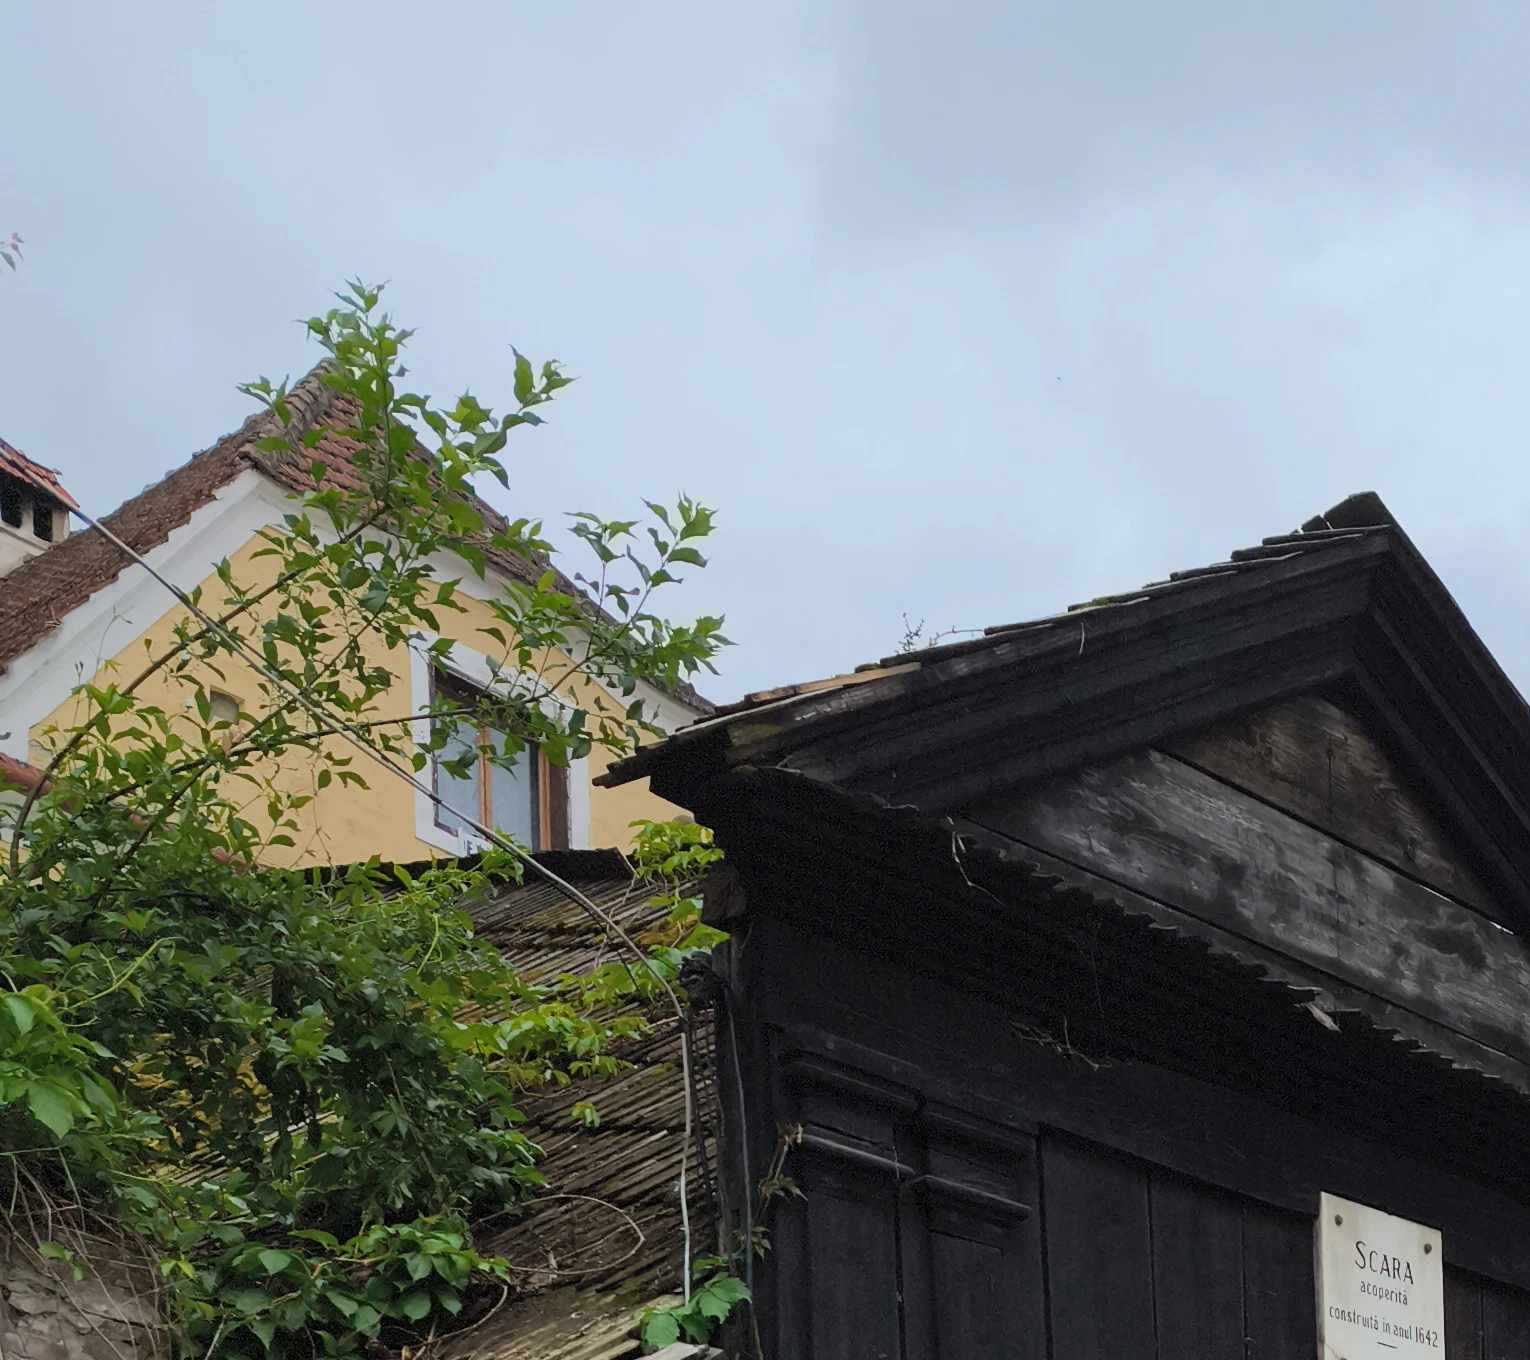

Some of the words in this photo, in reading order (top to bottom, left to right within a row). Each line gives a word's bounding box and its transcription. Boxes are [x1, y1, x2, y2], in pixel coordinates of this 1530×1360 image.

[1355, 1240, 1414, 1285] SCARA
[1360, 1280, 1408, 1305] acoperită
[1329, 1304, 1379, 1330] construită
[1393, 1324, 1412, 1340] anul
[1415, 1326, 1438, 1348] 1642
